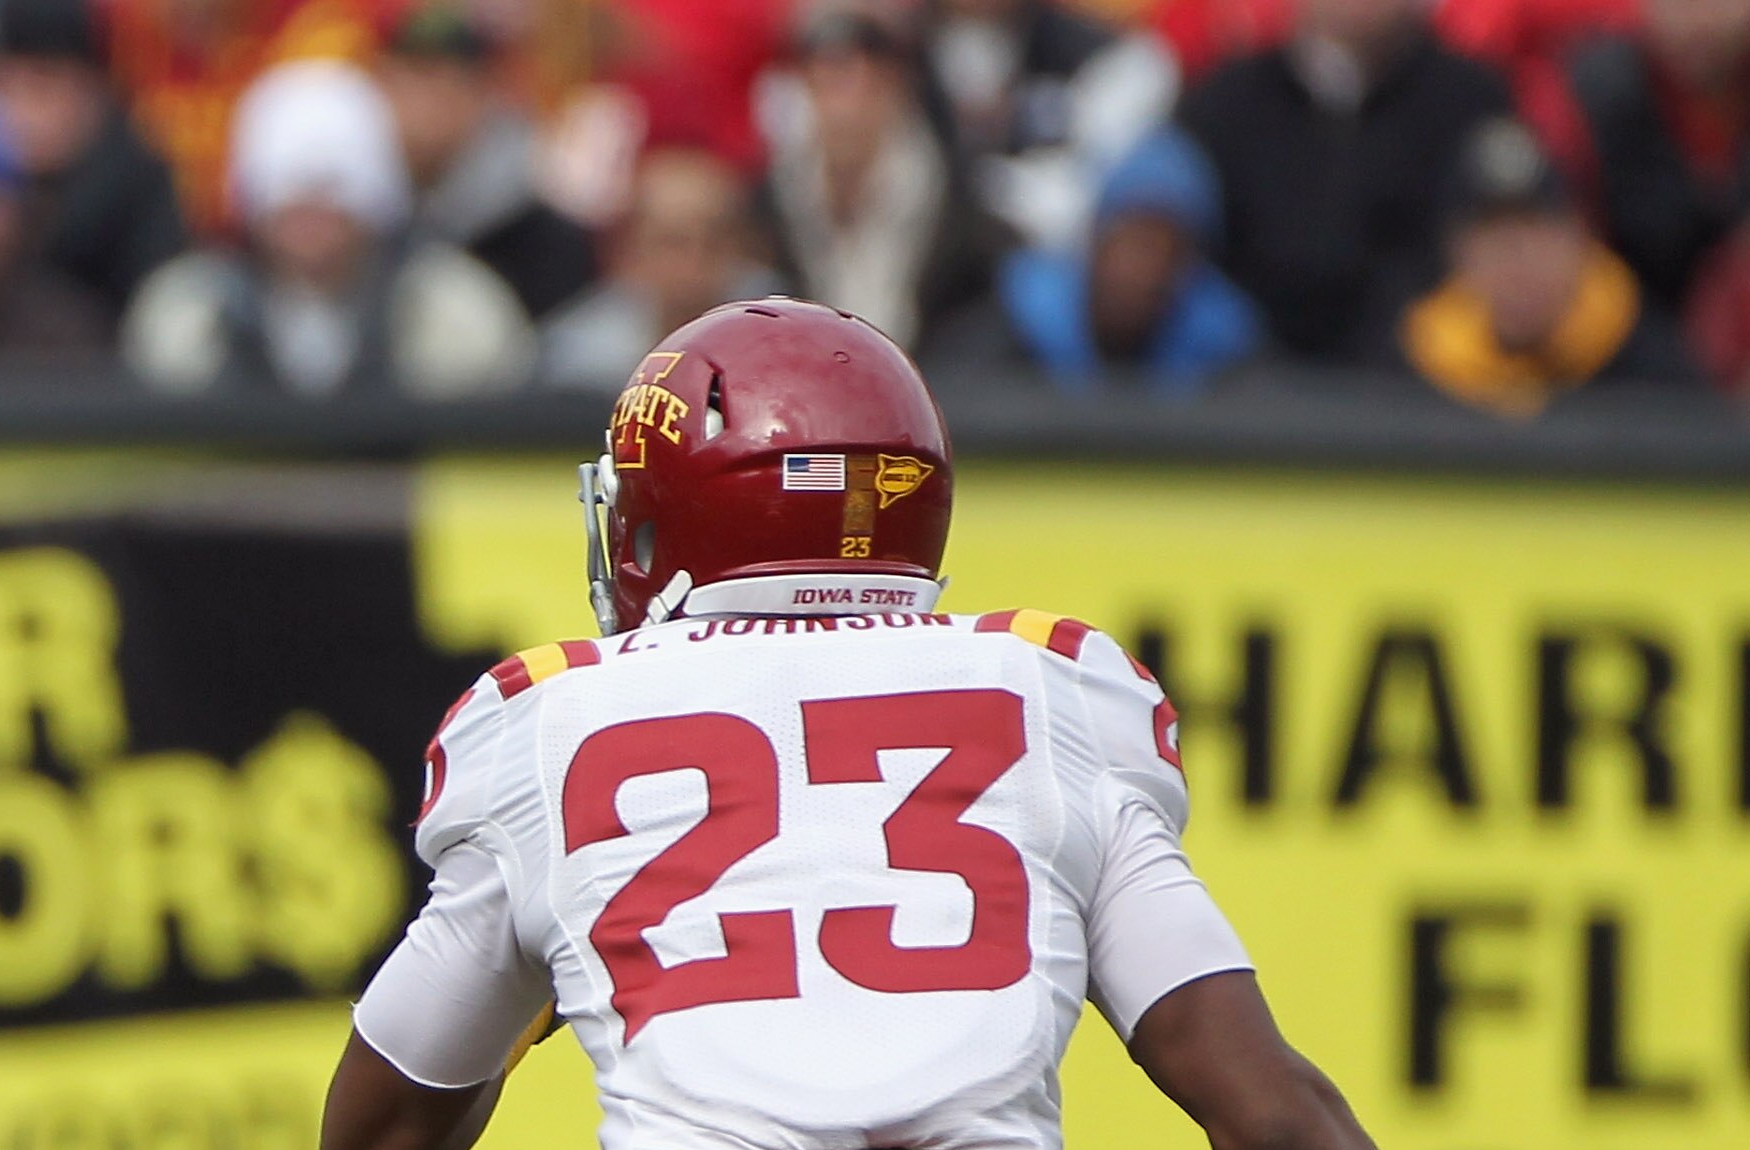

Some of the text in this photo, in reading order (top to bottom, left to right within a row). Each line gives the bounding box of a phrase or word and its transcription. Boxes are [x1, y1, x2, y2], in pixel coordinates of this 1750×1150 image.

[792, 587, 917, 606] IOWA STATE
[840, 536, 872, 558] 23
[1130, 622, 1750, 815] HAR
[562, 687, 1034, 1049] 23
[1402, 902, 1750, 1108] FL
